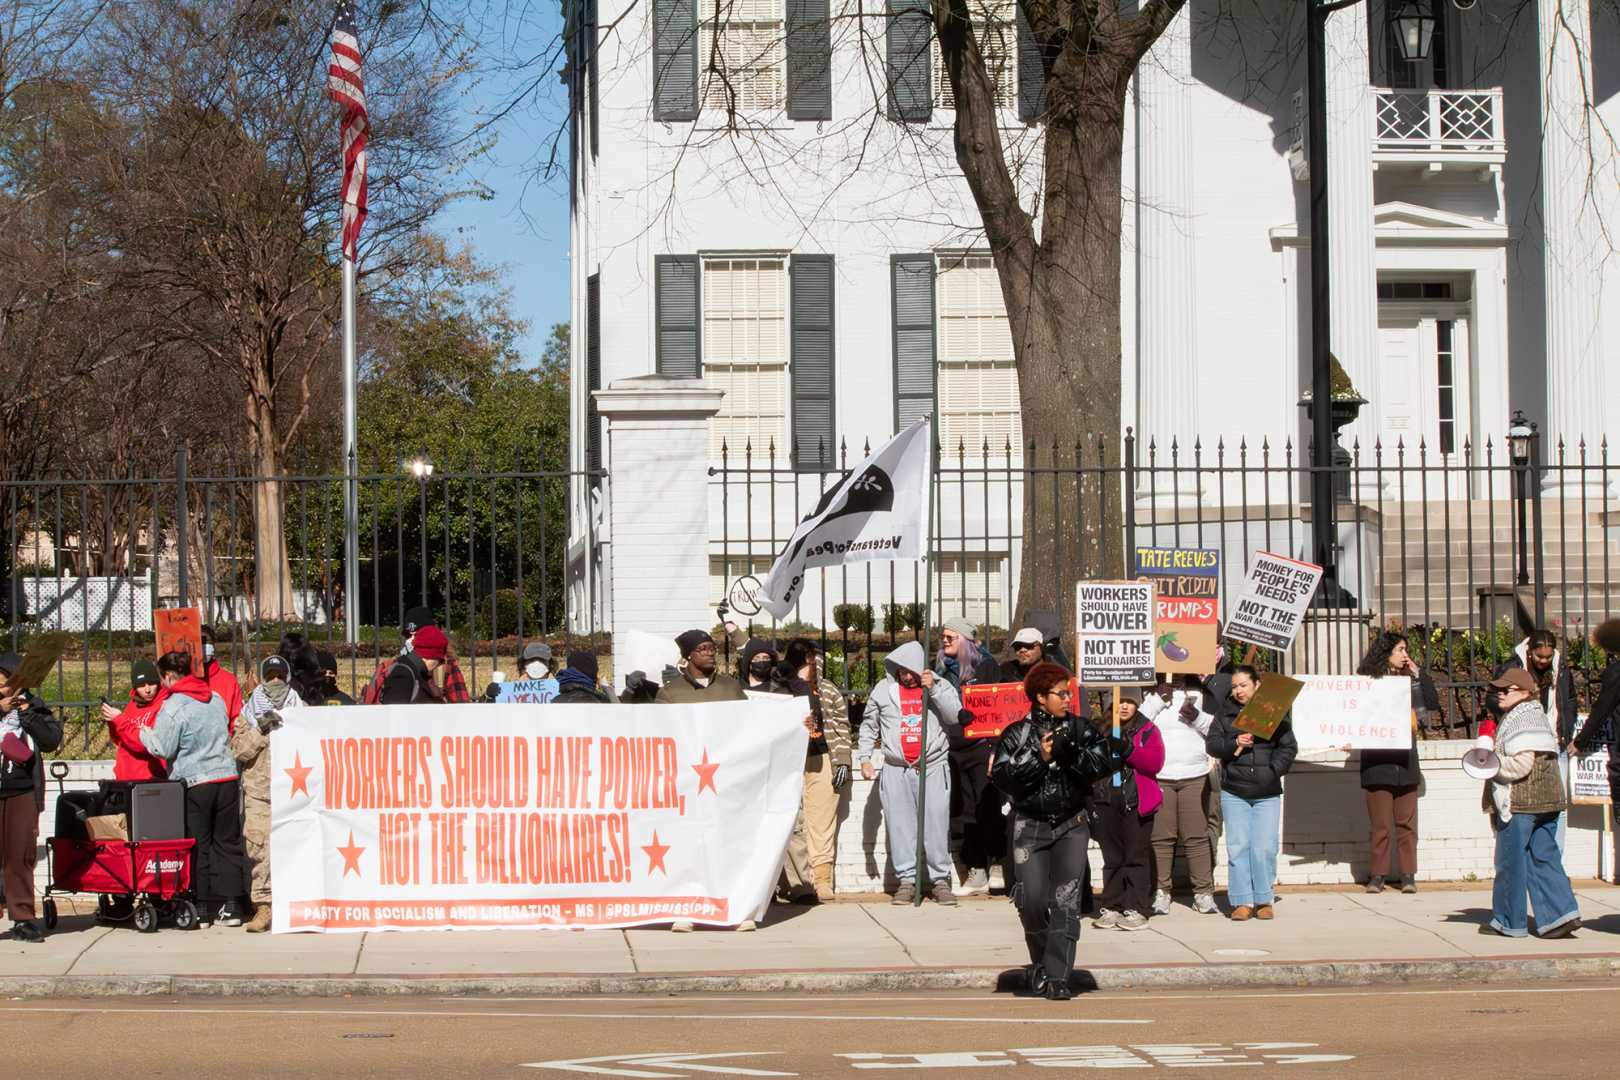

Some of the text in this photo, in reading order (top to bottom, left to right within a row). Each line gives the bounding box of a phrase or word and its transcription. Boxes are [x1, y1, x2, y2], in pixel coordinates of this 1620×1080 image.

[1137, 548, 1217, 569] TATE REEVES
[1256, 559, 1315, 583] MONEY FOR
[1176, 575, 1217, 596] RIDIN
[1251, 569, 1311, 595] PEOPLE'S
[1081, 587, 1148, 601] WORKERS
[1255, 583, 1297, 604] NEEDS
[1081, 601, 1148, 611] SHOULD HAVE
[1156, 600, 1214, 619] RUMP'S
[1239, 599, 1298, 626] NOT THE
[1081, 612, 1147, 630] POWER
[1234, 612, 1253, 624] WAR
[1253, 617, 1293, 634] MACHINE!
[1084, 639, 1151, 655] NOT THE
[1084, 656, 1151, 665] BILLIONAIRES!
[513, 681, 546, 692] MAKE
[1306, 680, 1374, 691] POVERTY
[965, 694, 998, 708] MONEY
[1343, 699, 1358, 710] IS
[1319, 723, 1398, 738] VIOLENCE
[1576, 759, 1603, 772] NOT
[320, 735, 686, 816] WORKERS SHOULD HAVE POWER,
[1576, 772, 1594, 780] WAR
[379, 812, 631, 885] NOT THE BILLIONAIRES!
[304, 906, 341, 920] PARTY
[345, 906, 370, 921] FOR
[374, 905, 446, 921] SOCIALISM
[450, 905, 476, 920] AND
[479, 903, 561, 920] LIBERATION
[575, 903, 594, 918] MS
